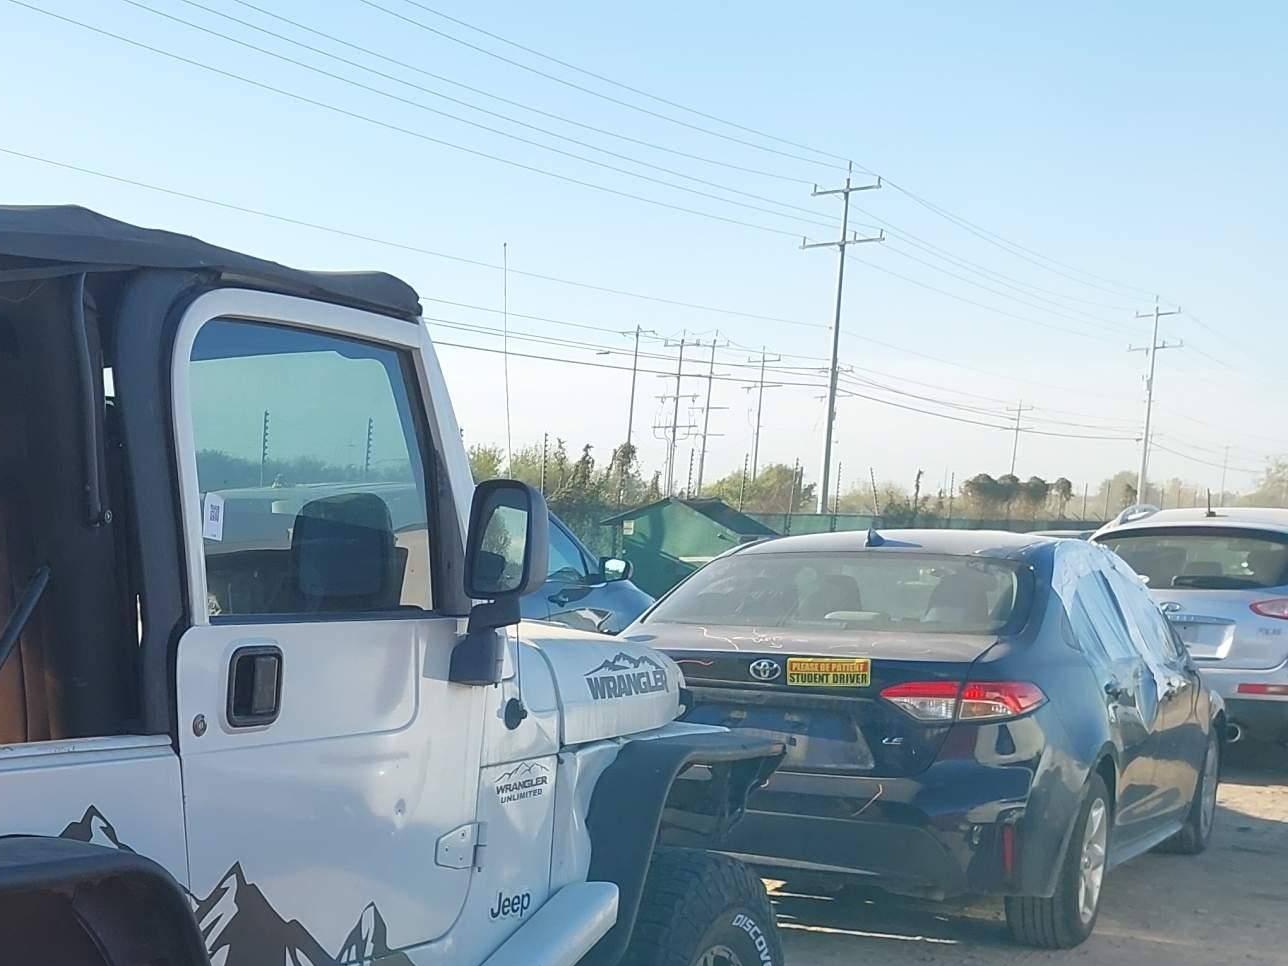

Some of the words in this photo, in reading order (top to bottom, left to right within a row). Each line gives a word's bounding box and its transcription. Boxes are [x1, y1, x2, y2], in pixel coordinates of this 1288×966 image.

[792, 661, 819, 671] PLEASE
[820, 662, 831, 672] BE
[832, 662, 865, 673] PATIENT
[585, 669, 670, 700] WRANGLER
[789, 673, 832, 684] STUDENT
[833, 673, 868, 684] DRIVER
[496, 775, 548, 796] WRANGLER
[500, 788, 543, 804] UNLIMITED
[490, 891, 531, 919] Jeep
